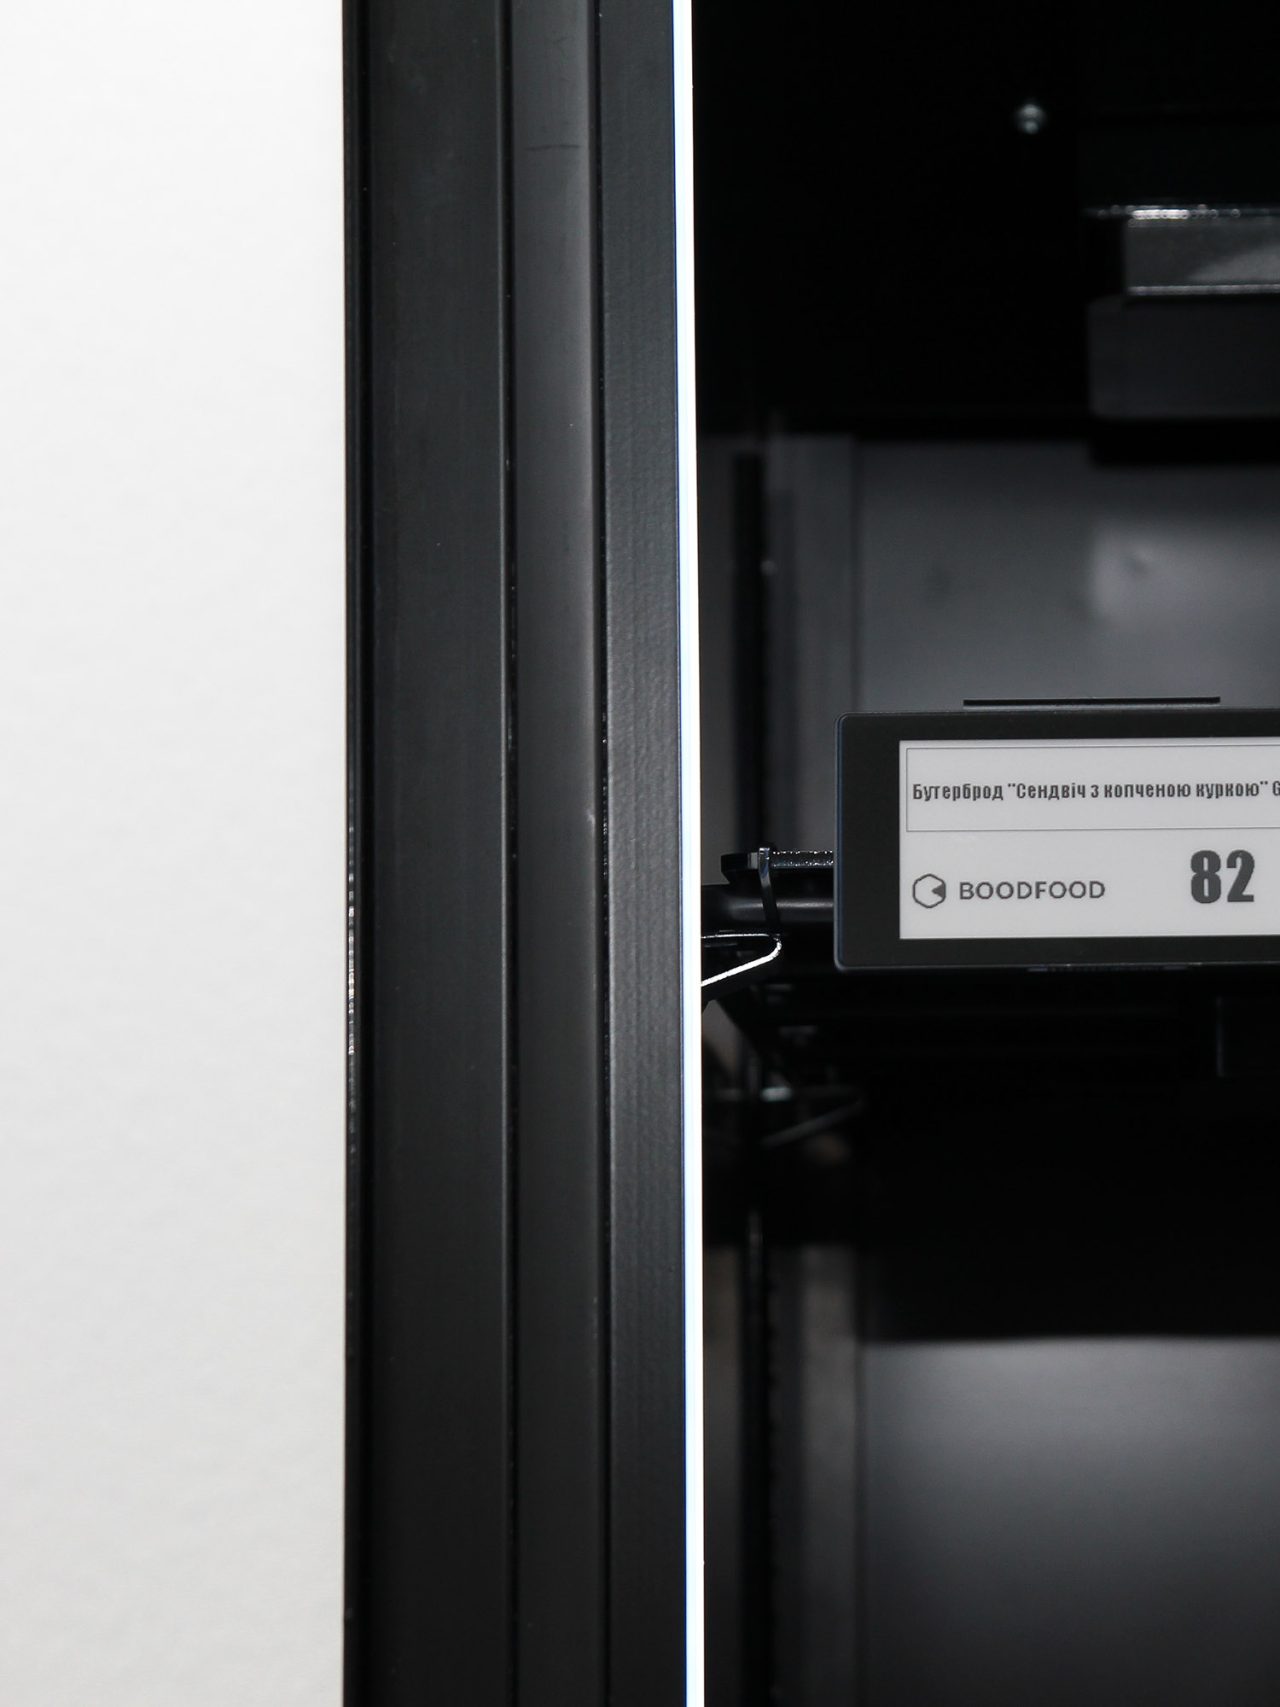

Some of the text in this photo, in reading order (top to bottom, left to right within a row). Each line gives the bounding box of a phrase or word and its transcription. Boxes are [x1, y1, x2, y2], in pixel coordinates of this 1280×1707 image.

[912, 783, 1004, 802] Бутерброд
[1090, 784, 1100, 799] з
[1103, 783, 1192, 799] копченою
[1189, 849, 1256, 905] 82
[959, 880, 1106, 901] BOODFOOD
